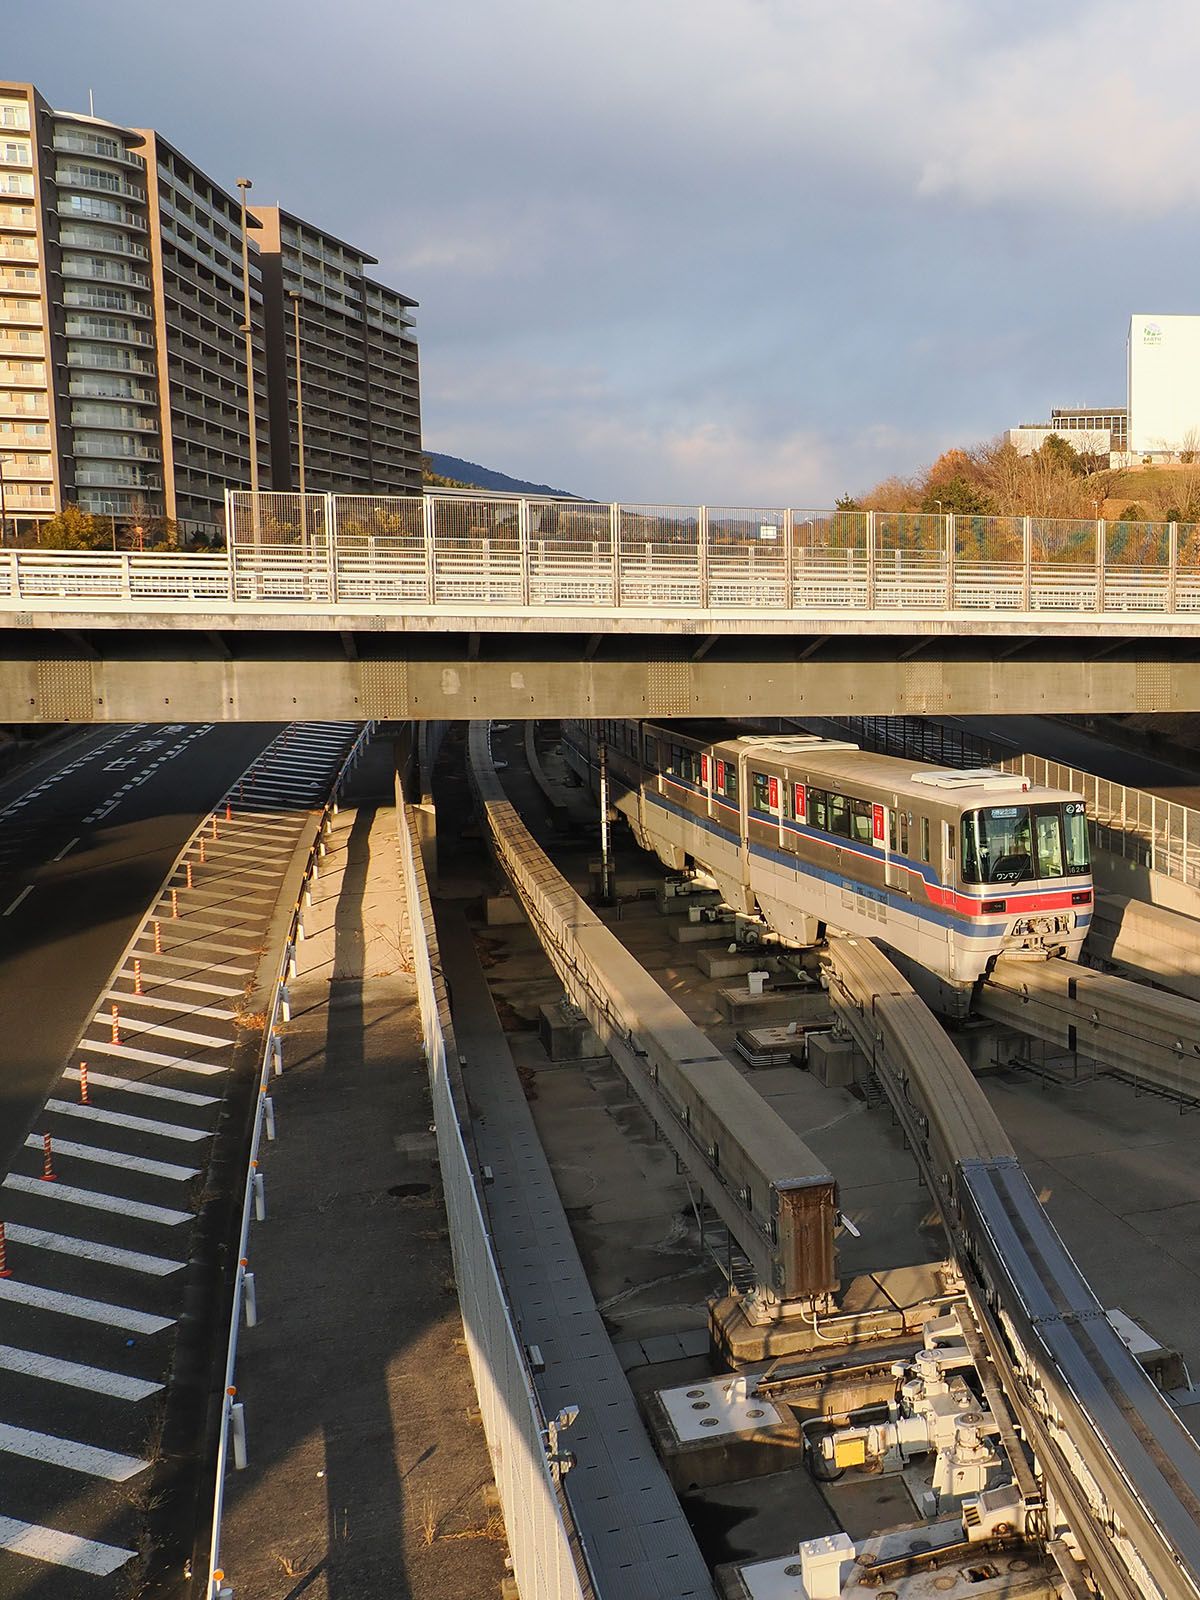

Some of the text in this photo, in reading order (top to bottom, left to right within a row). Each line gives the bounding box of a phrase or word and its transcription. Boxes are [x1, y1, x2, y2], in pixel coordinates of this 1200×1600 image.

[1075, 803, 1085, 813] 24
[996, 871, 1020, 880] ワンマン
